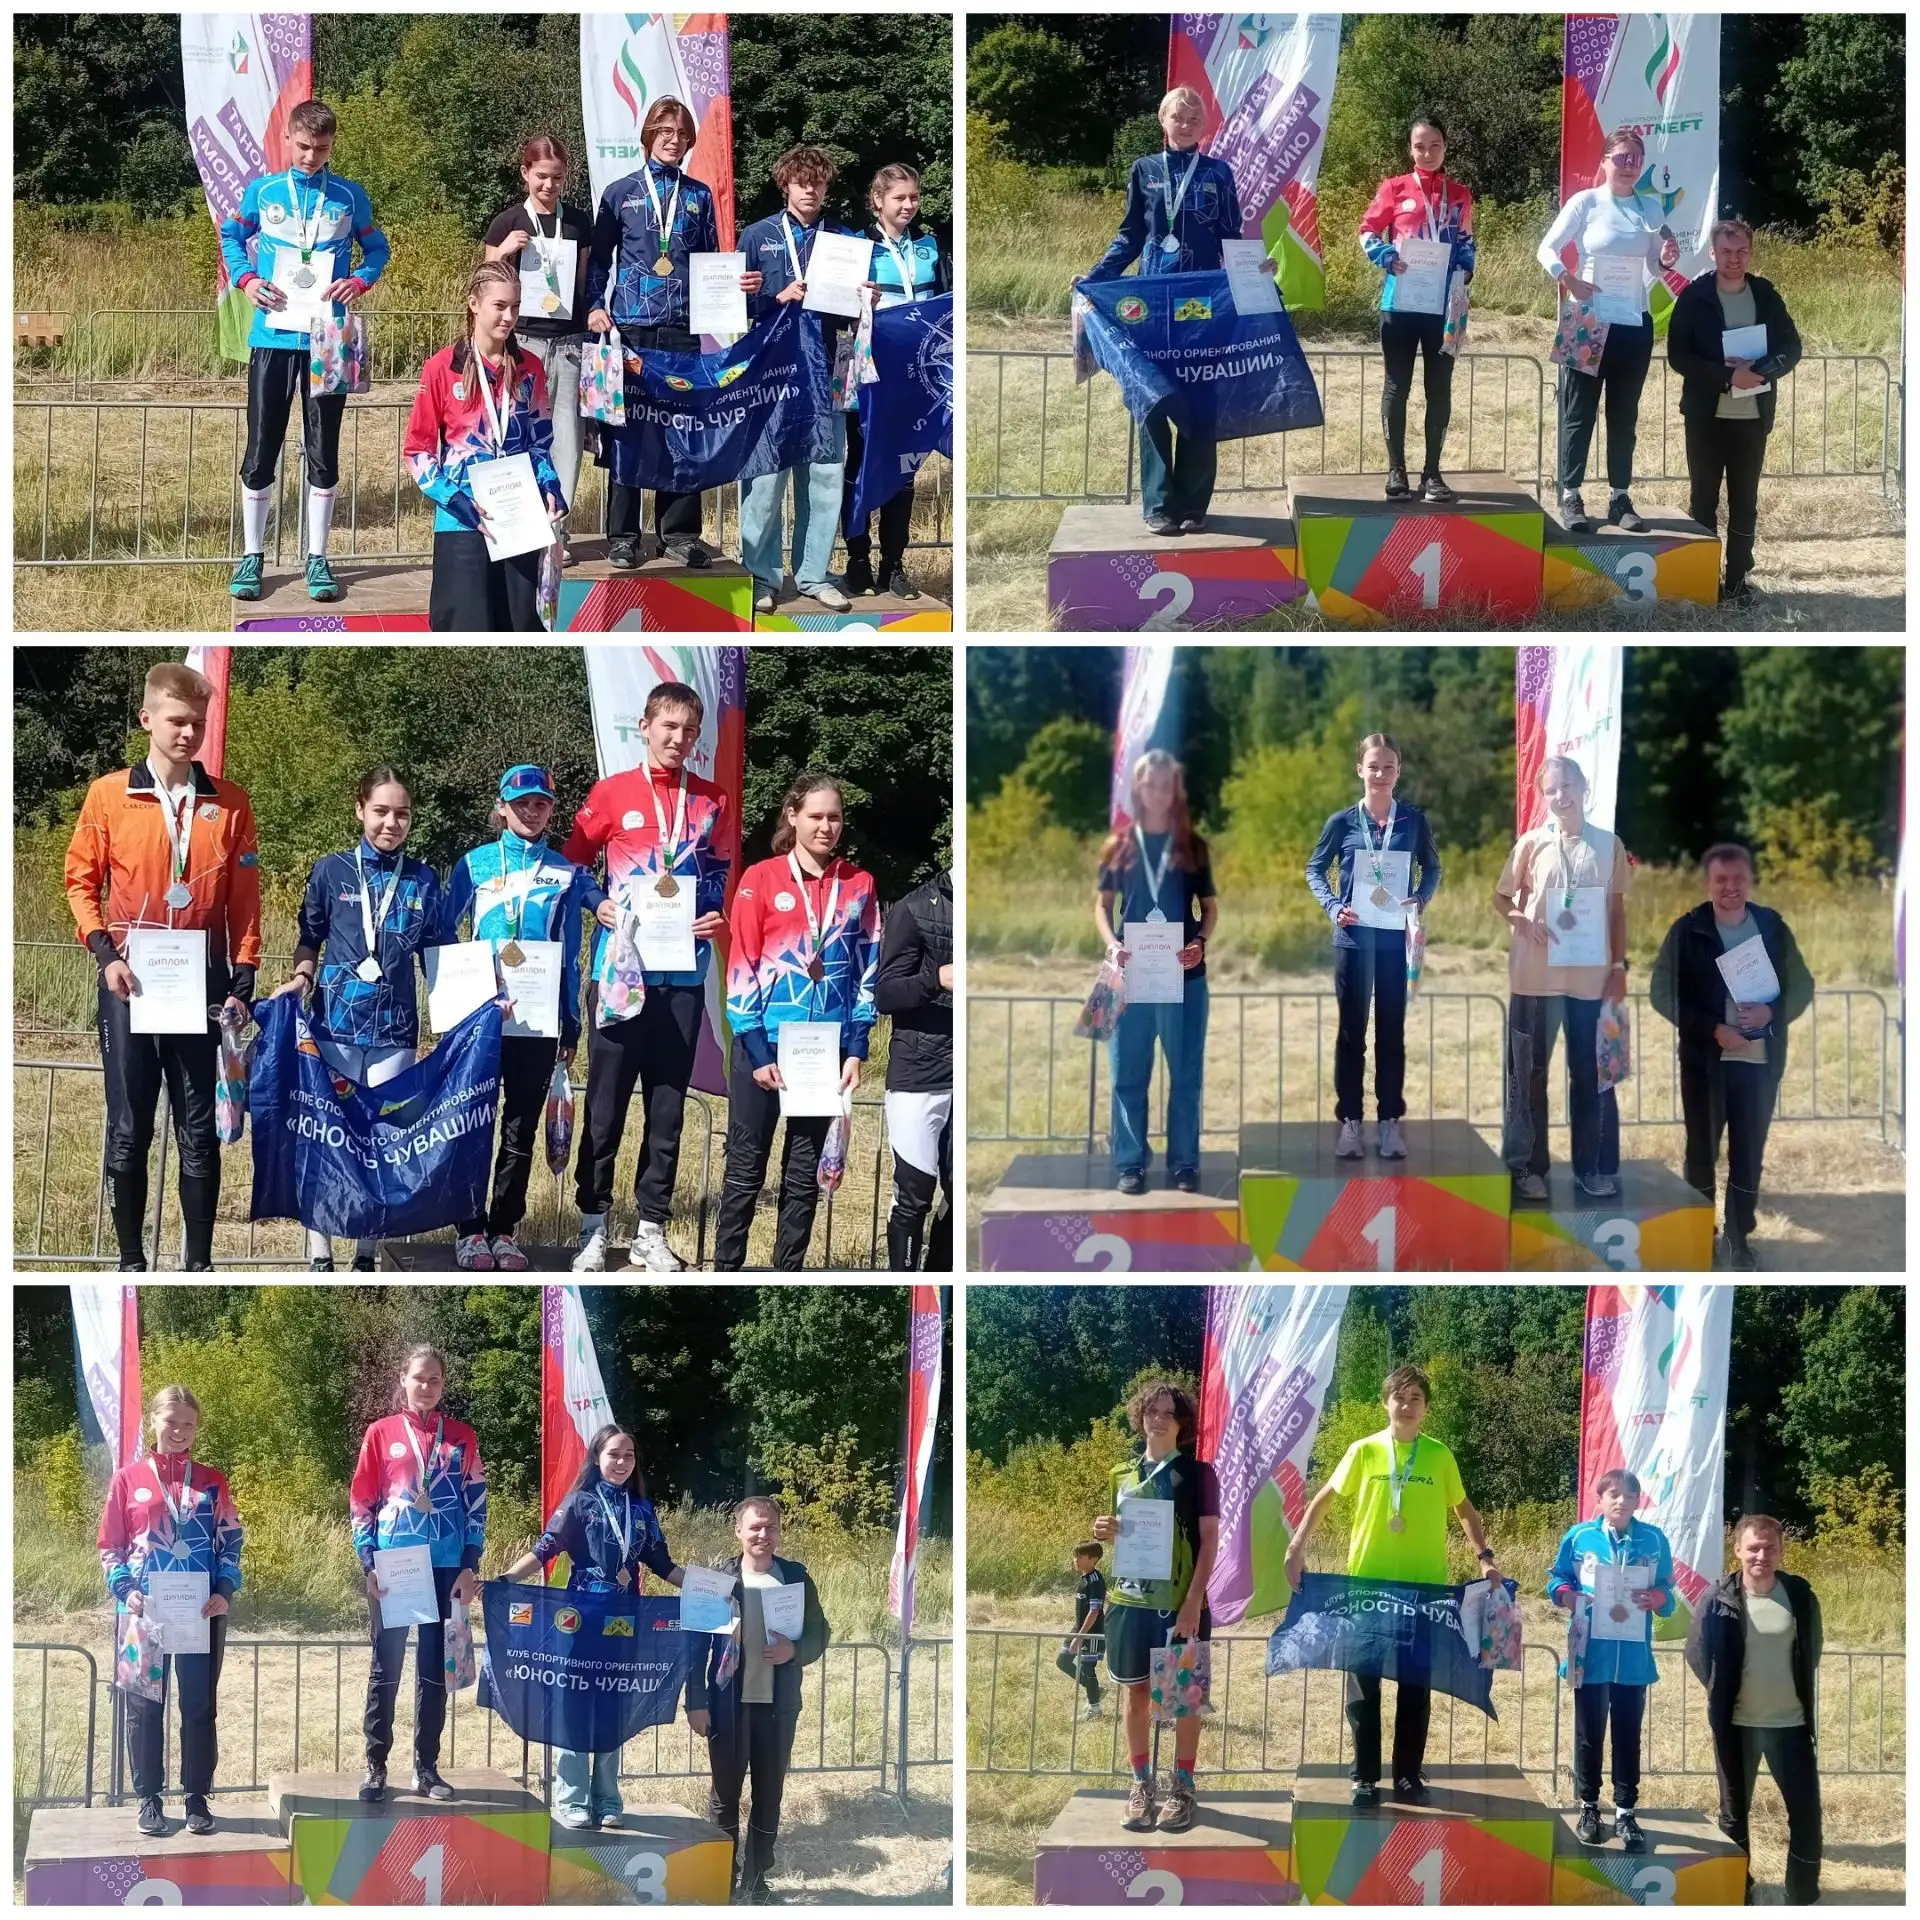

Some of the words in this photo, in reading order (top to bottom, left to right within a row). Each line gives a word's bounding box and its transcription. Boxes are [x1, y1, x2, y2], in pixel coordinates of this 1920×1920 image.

[1176, 351, 1284, 384] ЧУВАШИИ»
[1184, 333, 1281, 357] ОРИЕНТИРОВАНИЯ
[1138, 571, 1194, 632] 2
[1408, 542, 1442, 610] 1
[1615, 551, 1658, 608] 3
[148, 958, 189, 967] ДИПЛОМ
[1361, 1205, 1396, 1272] 1
[1593, 1217, 1641, 1272] 3
[505, 1664, 589, 1691] «ЮНОСТЬ
[507, 1648, 530, 1659] КЛУБ
[532, 1652, 602, 1670] СПОРТИВНОГО
[410, 1845, 443, 1906] 1
[624, 1852, 668, 1906] 3
[1408, 1848, 1444, 1906] 1
